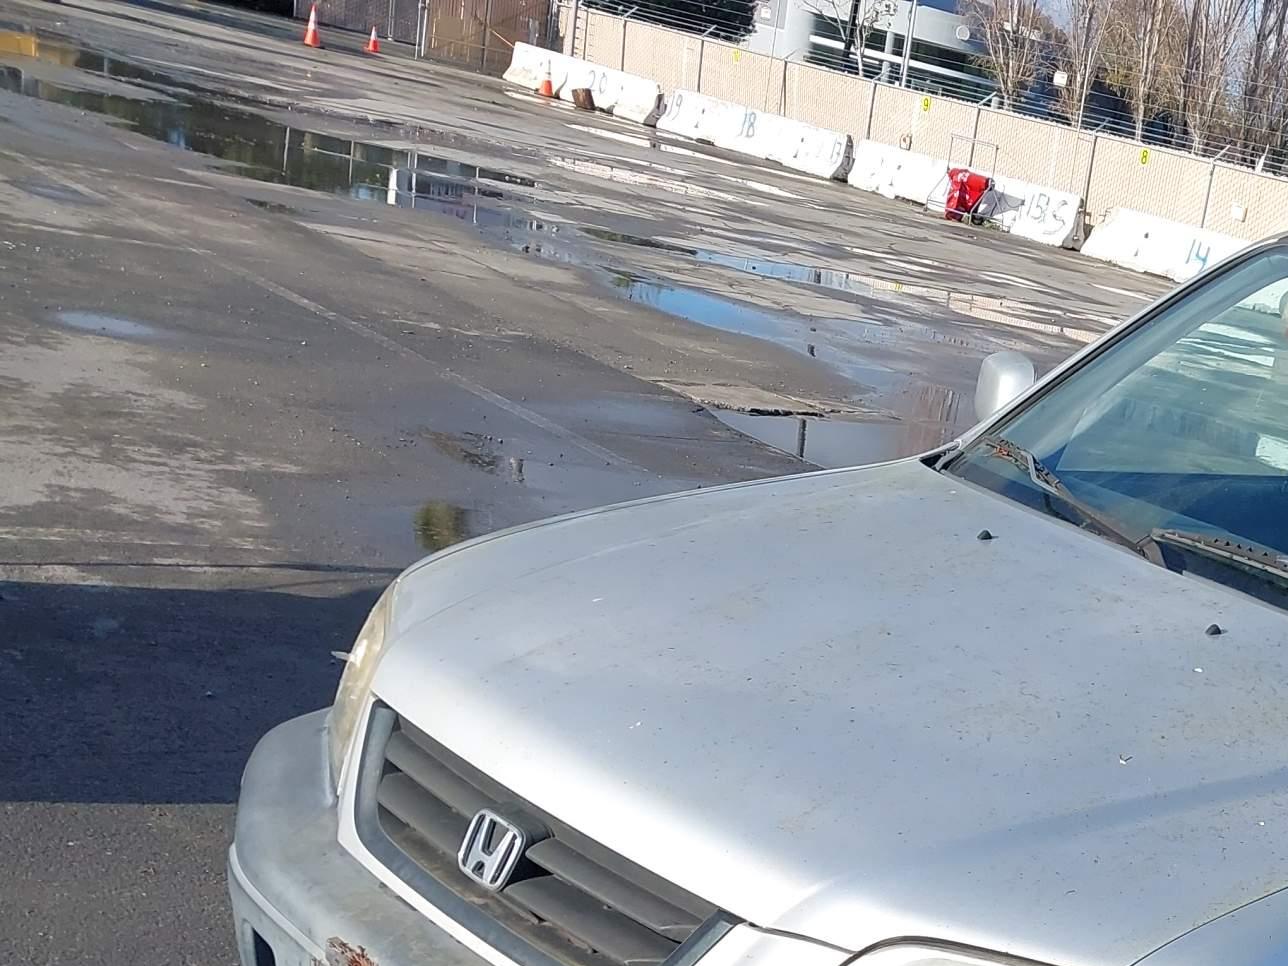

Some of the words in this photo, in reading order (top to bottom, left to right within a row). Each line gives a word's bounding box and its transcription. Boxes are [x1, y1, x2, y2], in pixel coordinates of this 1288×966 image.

[739, 110, 758, 138] 18
[1141, 150, 1148, 164] 8
[1185, 239, 1211, 272] 14
